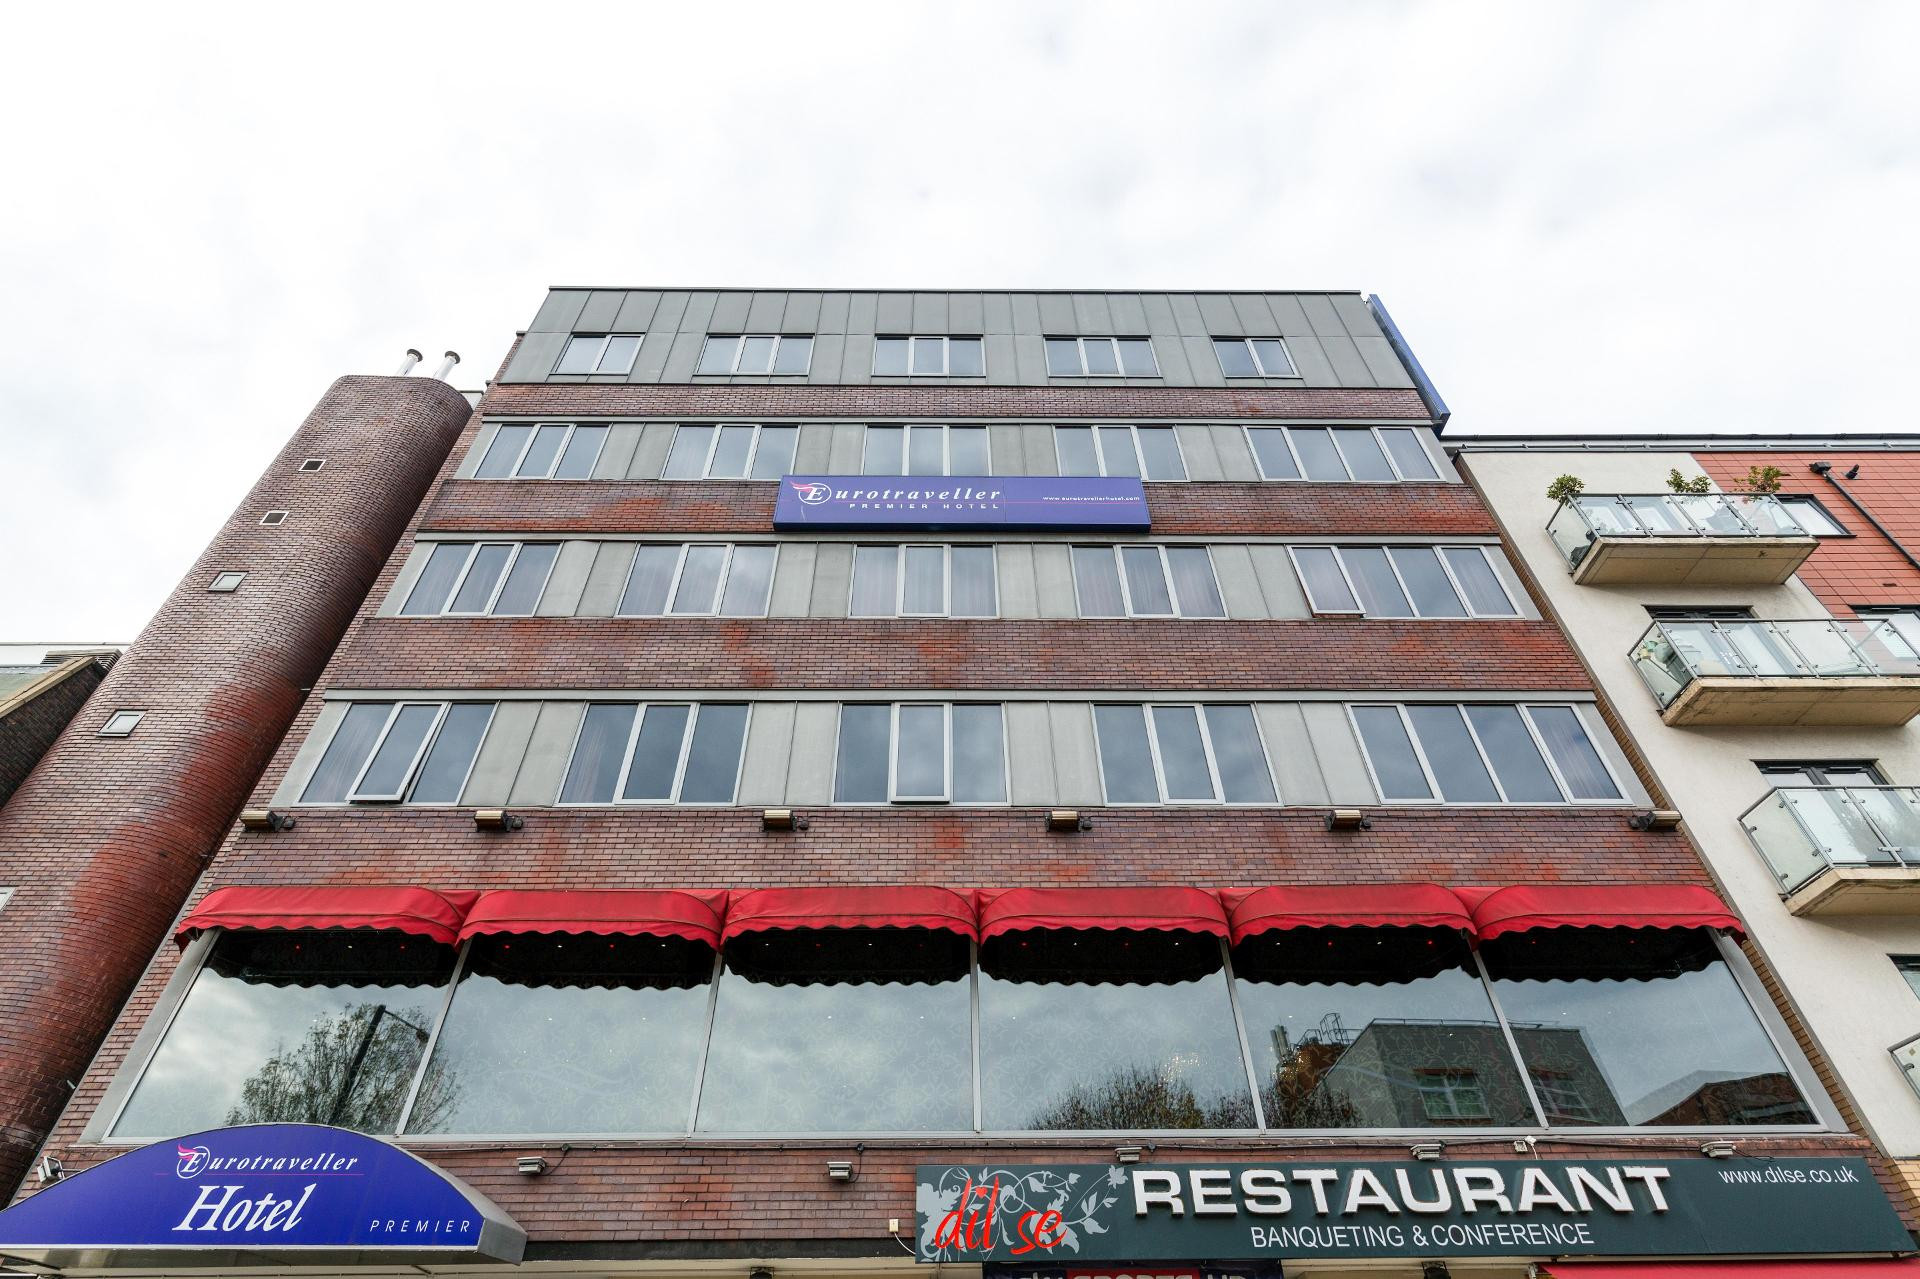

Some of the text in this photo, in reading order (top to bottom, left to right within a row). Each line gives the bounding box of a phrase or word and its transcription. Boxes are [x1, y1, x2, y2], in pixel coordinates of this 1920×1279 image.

[798, 484, 1000, 502] Eurotraveller
[177, 1147, 359, 1178] Eurotraveller
[1718, 1165, 1859, 1184] www.dilse.co.uk
[1132, 1167, 1671, 1216] RESTAURANT
[172, 1182, 317, 1232] Hotel
[369, 1219, 471, 1233] PREMIER
[1251, 1223, 1595, 1248] BANQUETING & CONFERENCE
